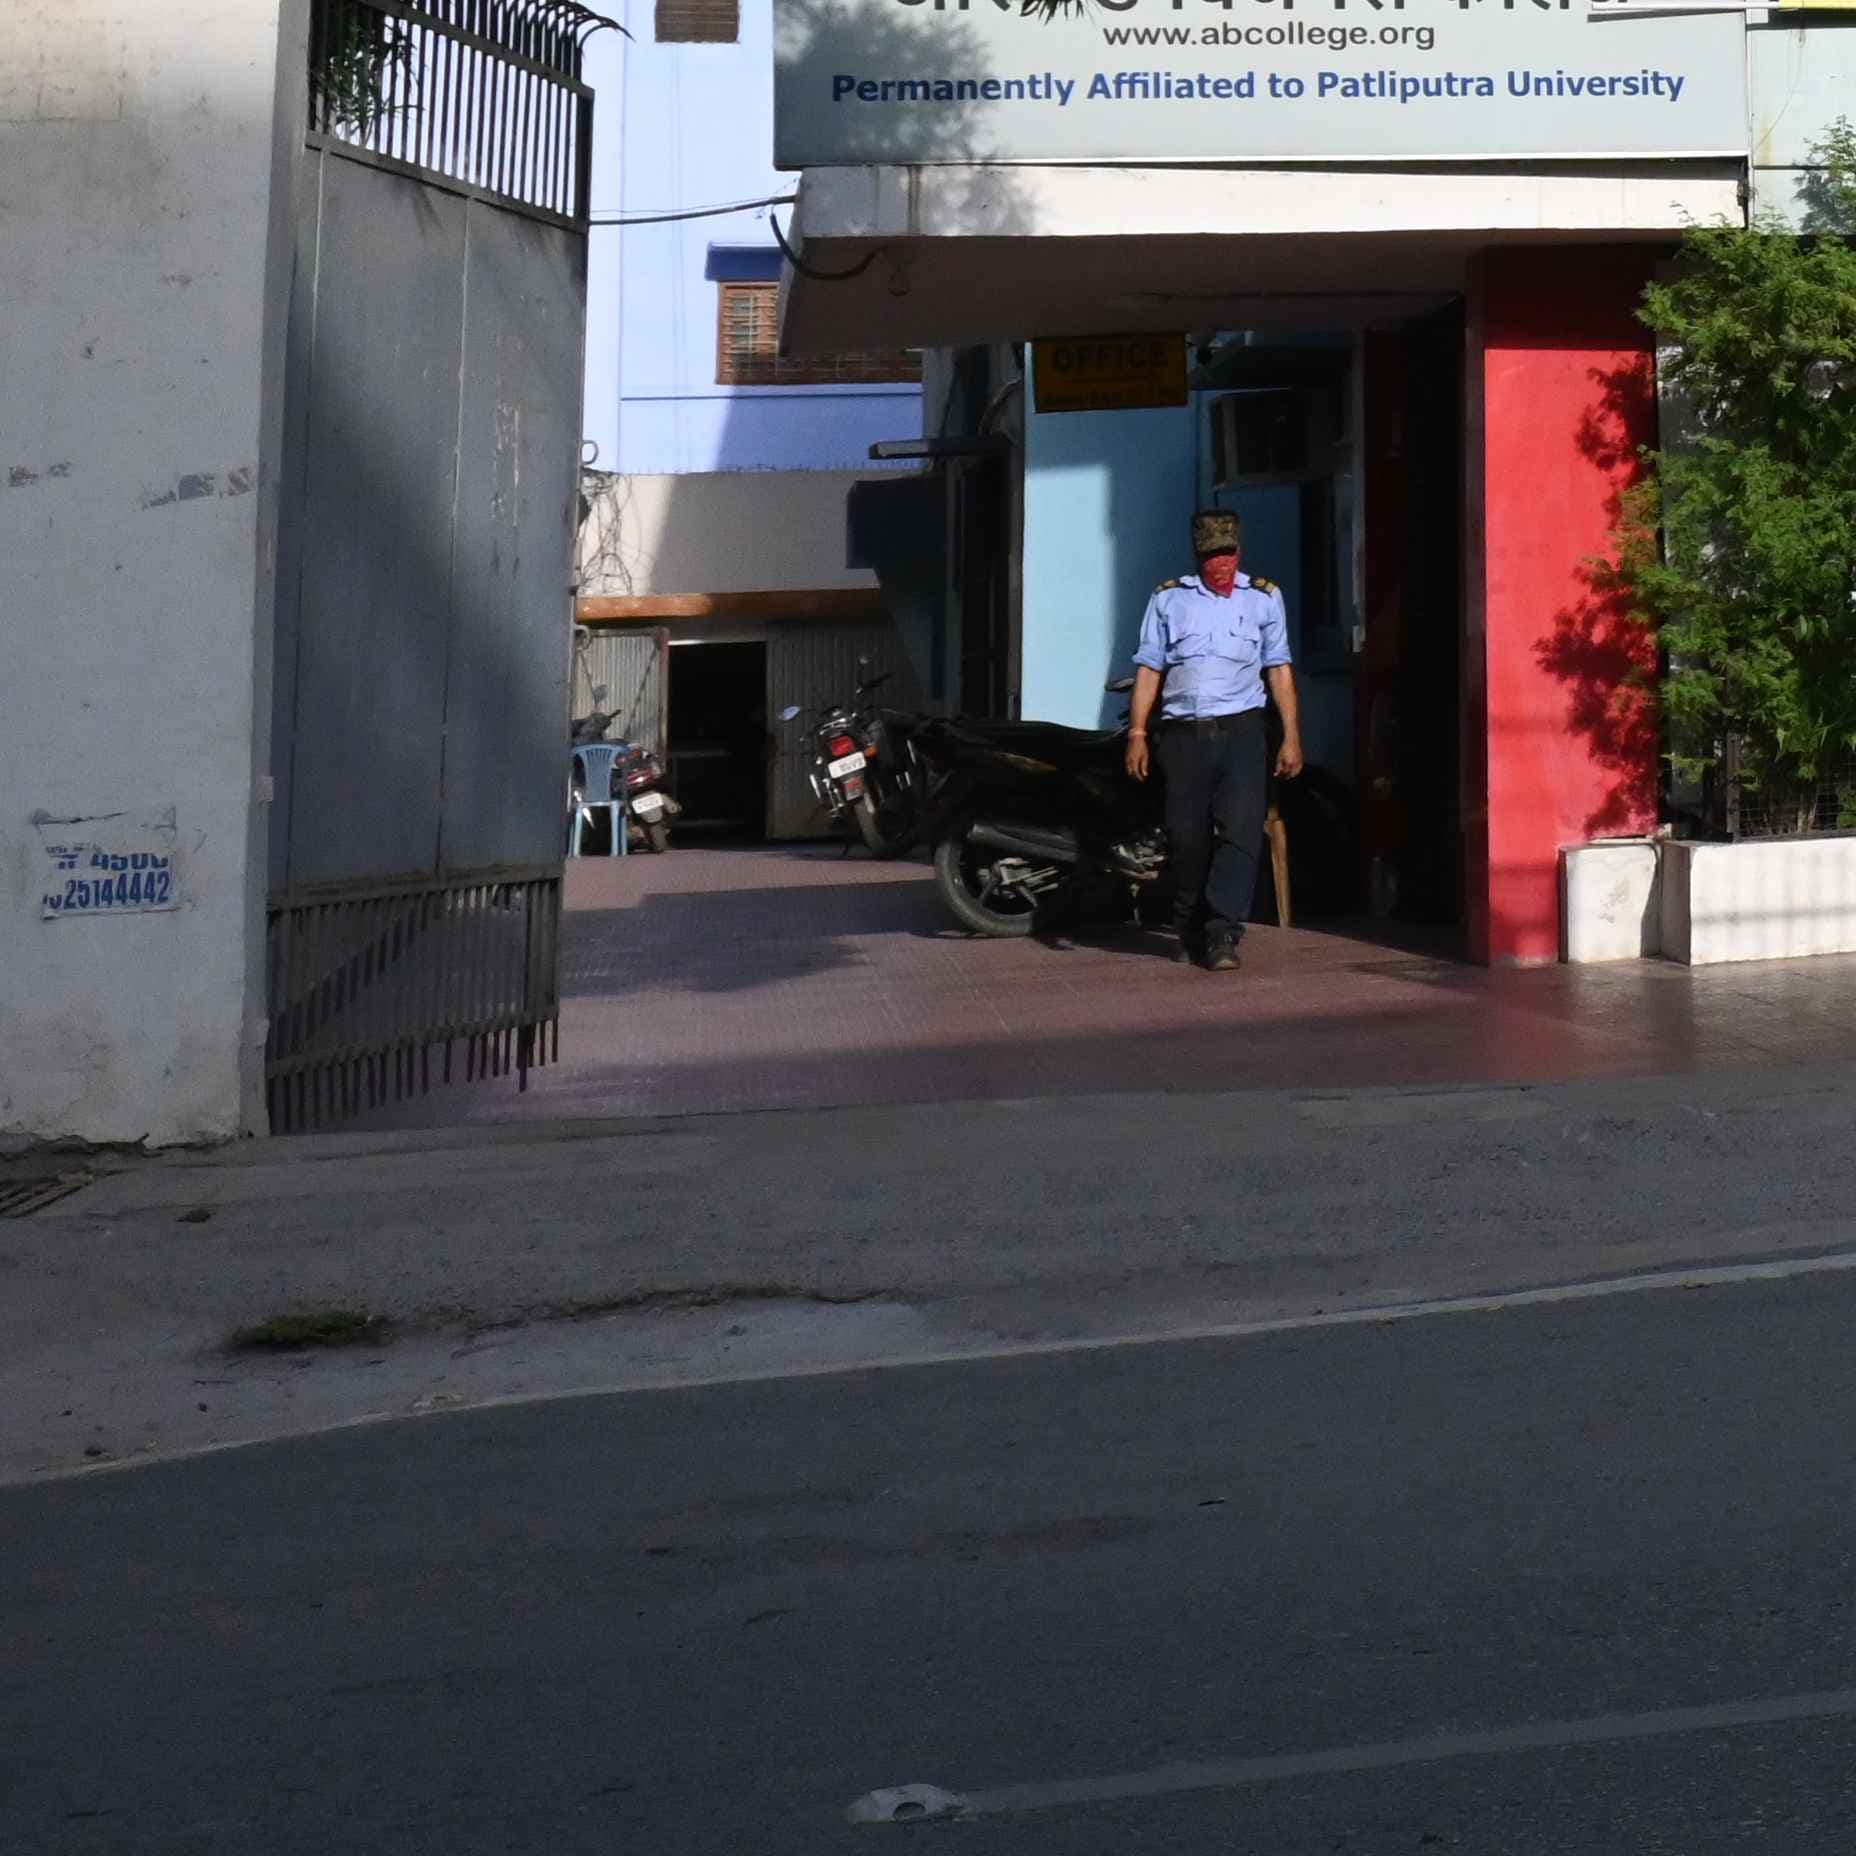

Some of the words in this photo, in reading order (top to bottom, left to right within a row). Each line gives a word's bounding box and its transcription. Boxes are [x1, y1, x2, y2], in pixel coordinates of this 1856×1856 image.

[1102, 21, 1436, 51] www.abcollege.org
[832, 72, 1076, 106] Permanently
[1087, 69, 1257, 101] Affiliated
[1268, 73, 1306, 99] to
[1317, 69, 1496, 103] Patliputra
[1507, 69, 1685, 102] University
[1053, 343, 1170, 370] OFFICE
